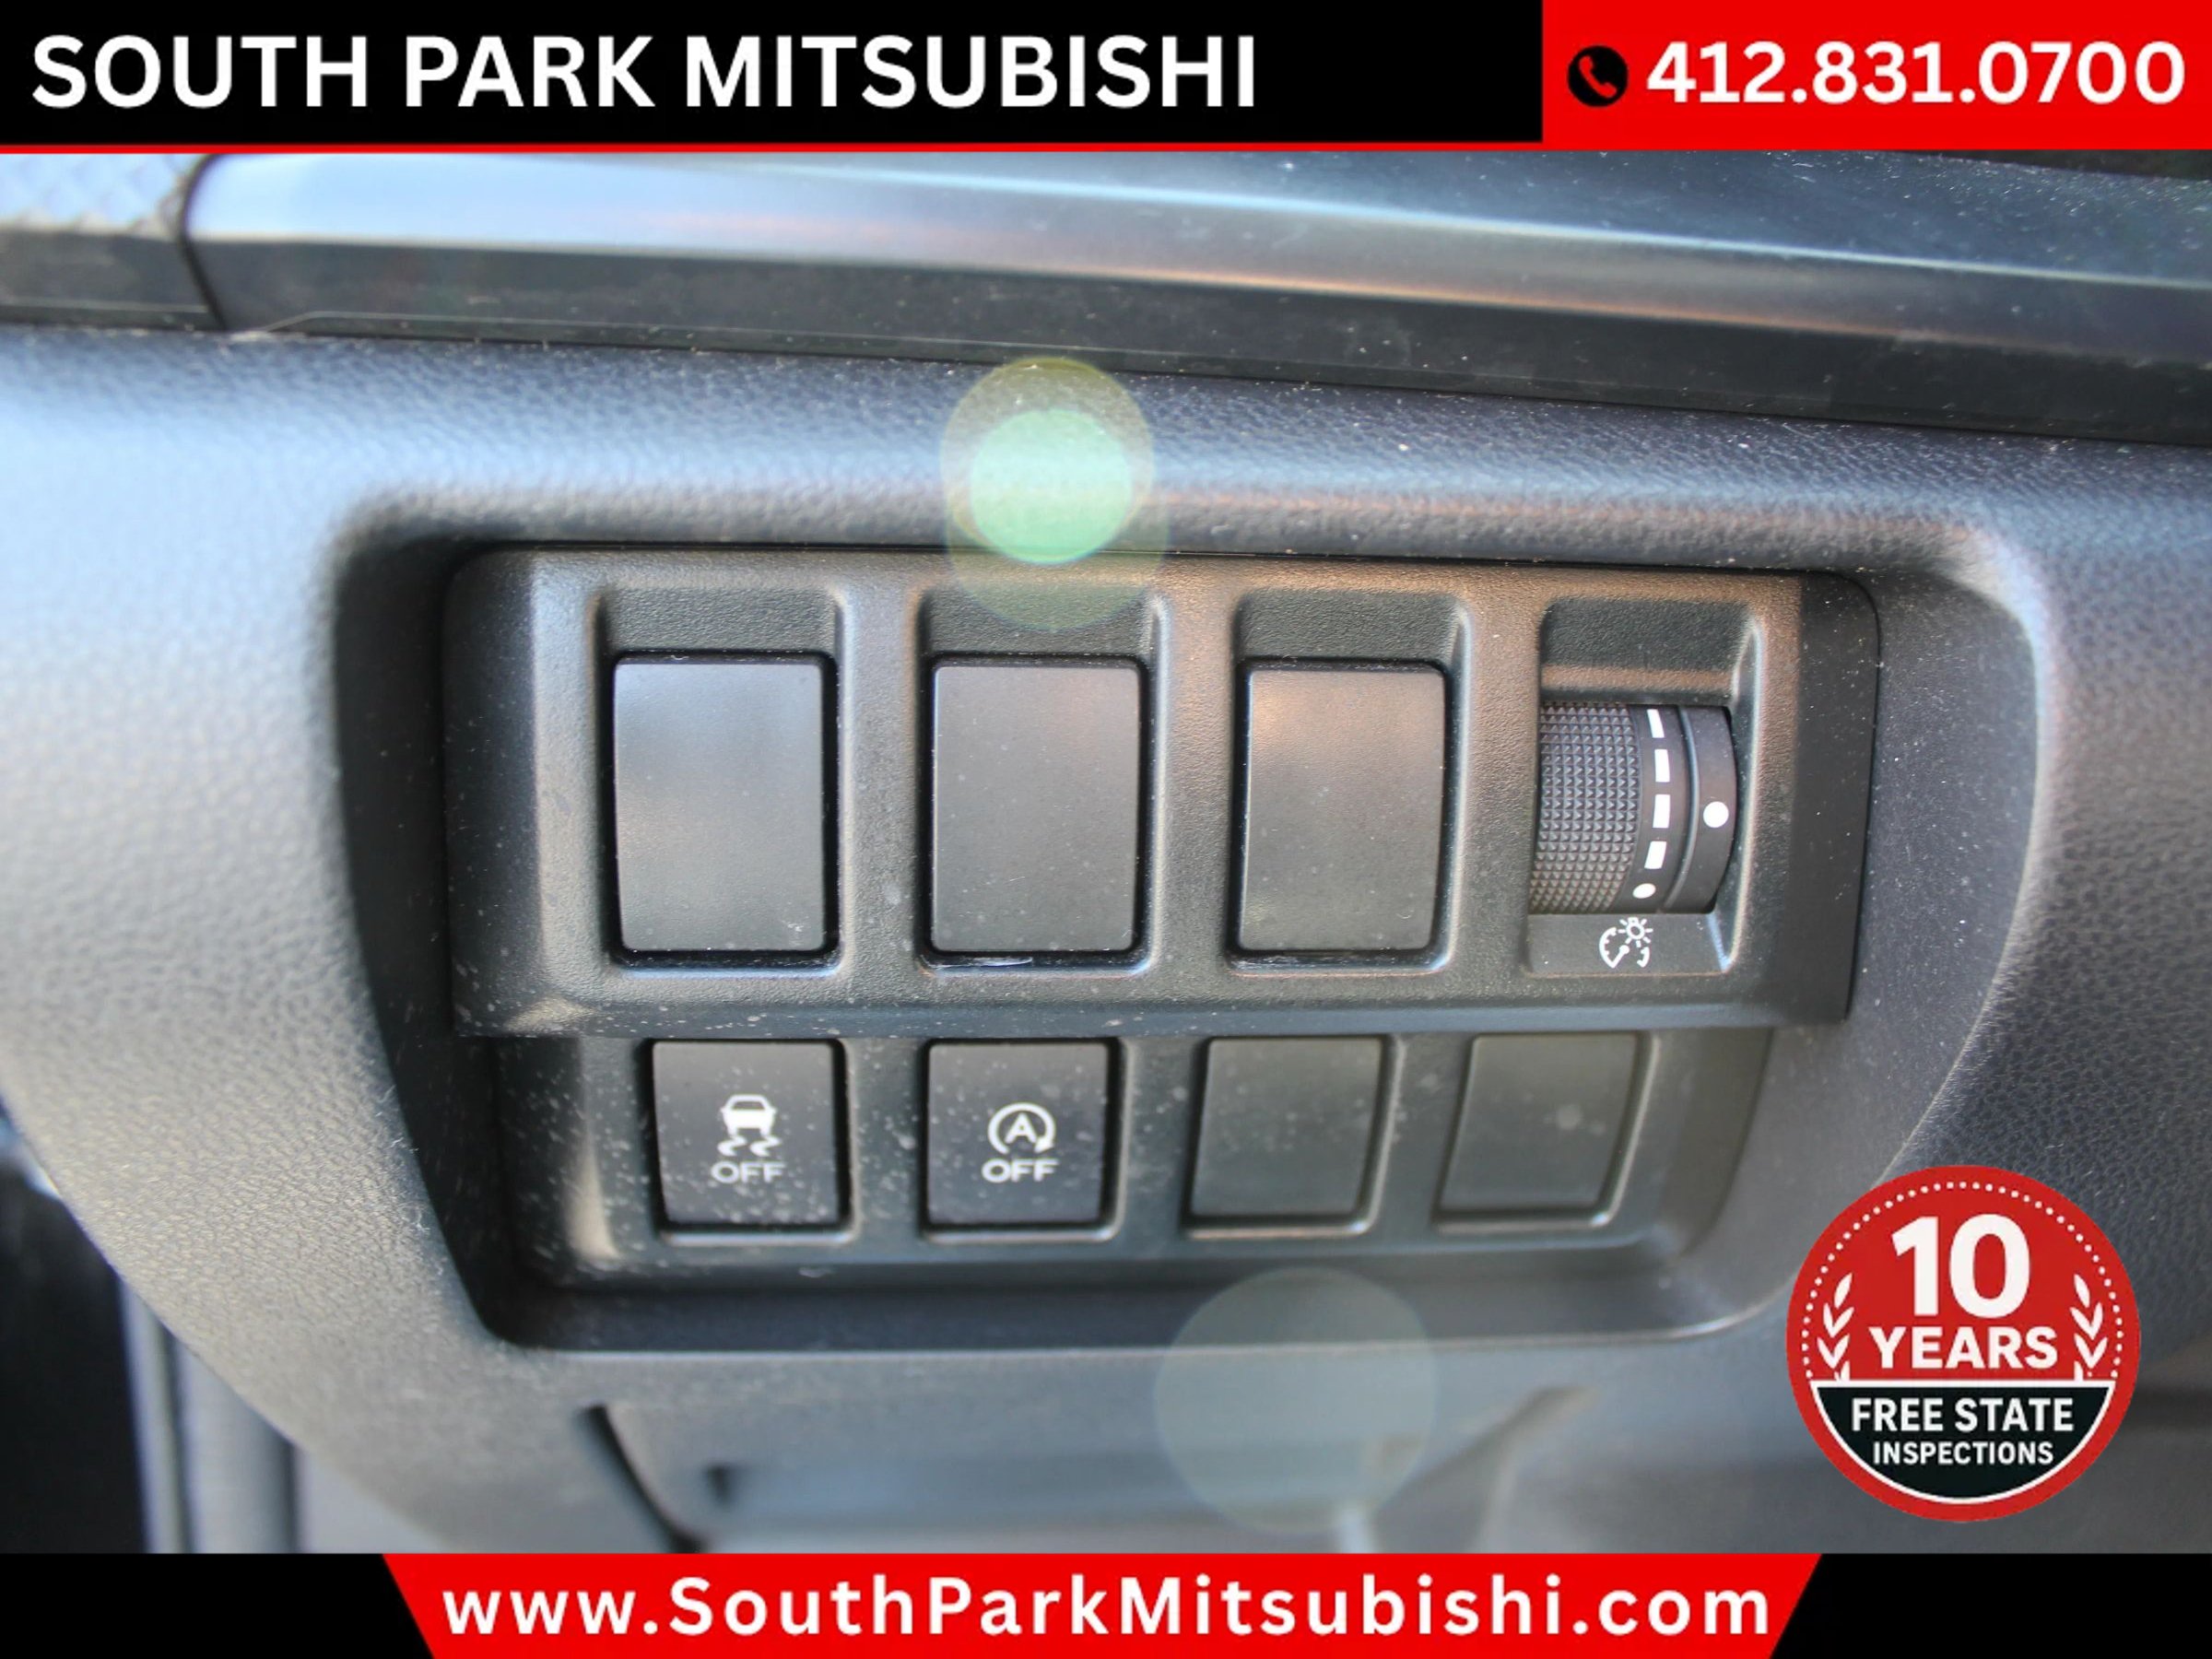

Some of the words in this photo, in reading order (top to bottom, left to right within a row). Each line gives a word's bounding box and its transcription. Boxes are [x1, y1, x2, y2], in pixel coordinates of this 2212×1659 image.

[1005, 1112, 1037, 1144] A
[711, 1160, 786, 1183] OFF
[981, 1159, 1059, 1182] OFF
